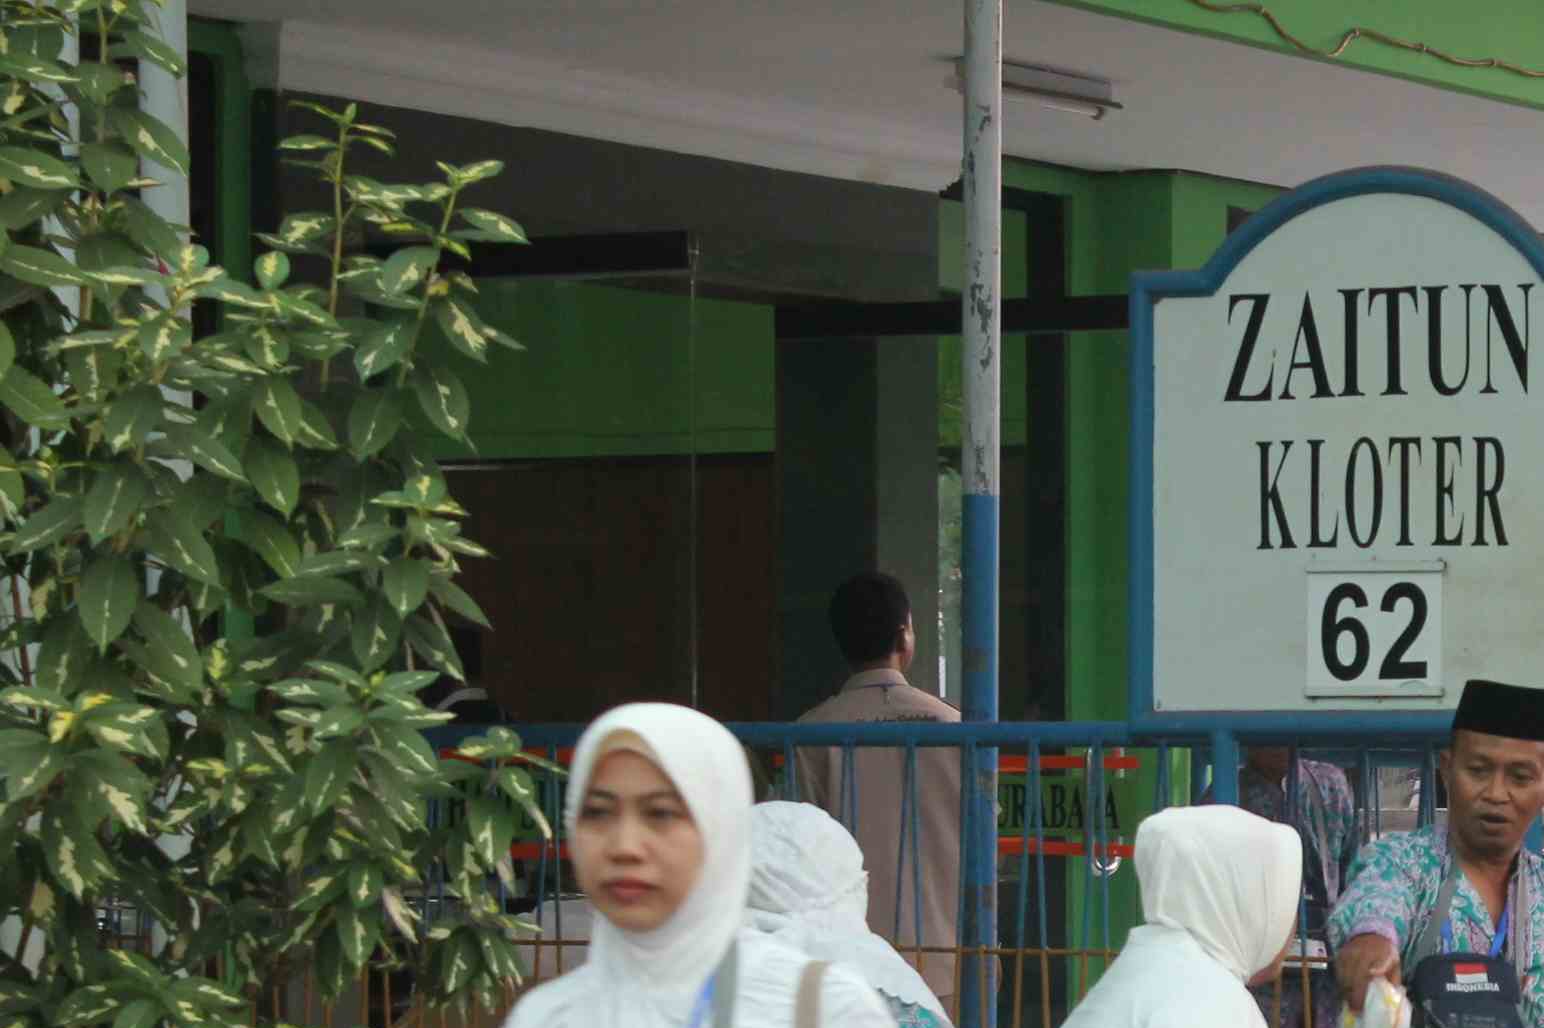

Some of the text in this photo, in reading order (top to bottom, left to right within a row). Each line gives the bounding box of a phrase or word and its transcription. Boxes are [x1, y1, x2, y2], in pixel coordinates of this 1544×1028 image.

[1223, 283, 1535, 402] ZAITUN
[1255, 436, 1509, 550] KLOTER
[1320, 581, 1428, 681] 62
